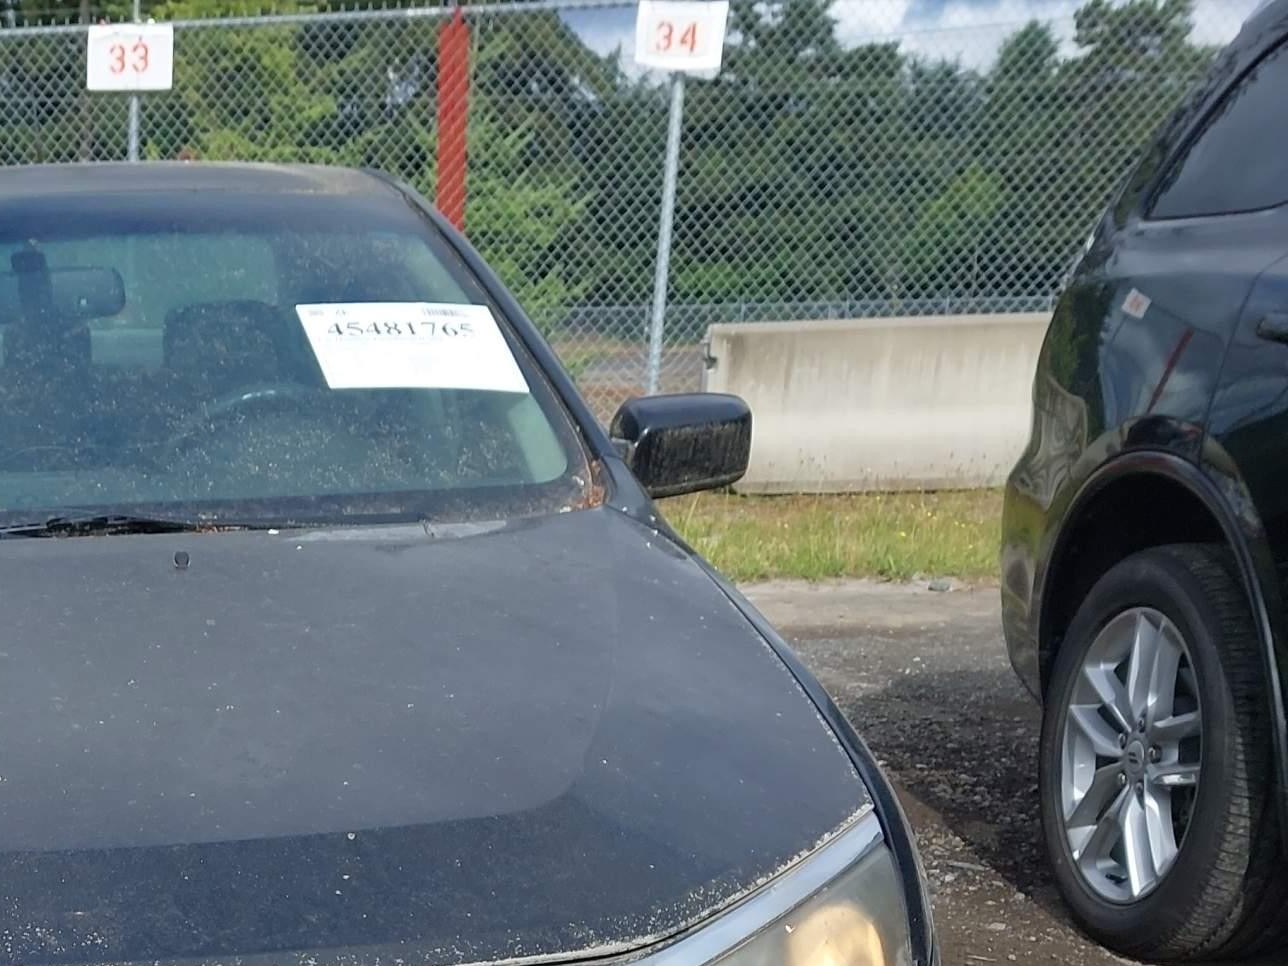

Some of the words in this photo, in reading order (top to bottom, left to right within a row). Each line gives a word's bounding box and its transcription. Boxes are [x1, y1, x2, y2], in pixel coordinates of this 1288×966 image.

[655, 20, 698, 53] 34
[109, 43, 149, 74] 33
[327, 320, 476, 338] 45481765
